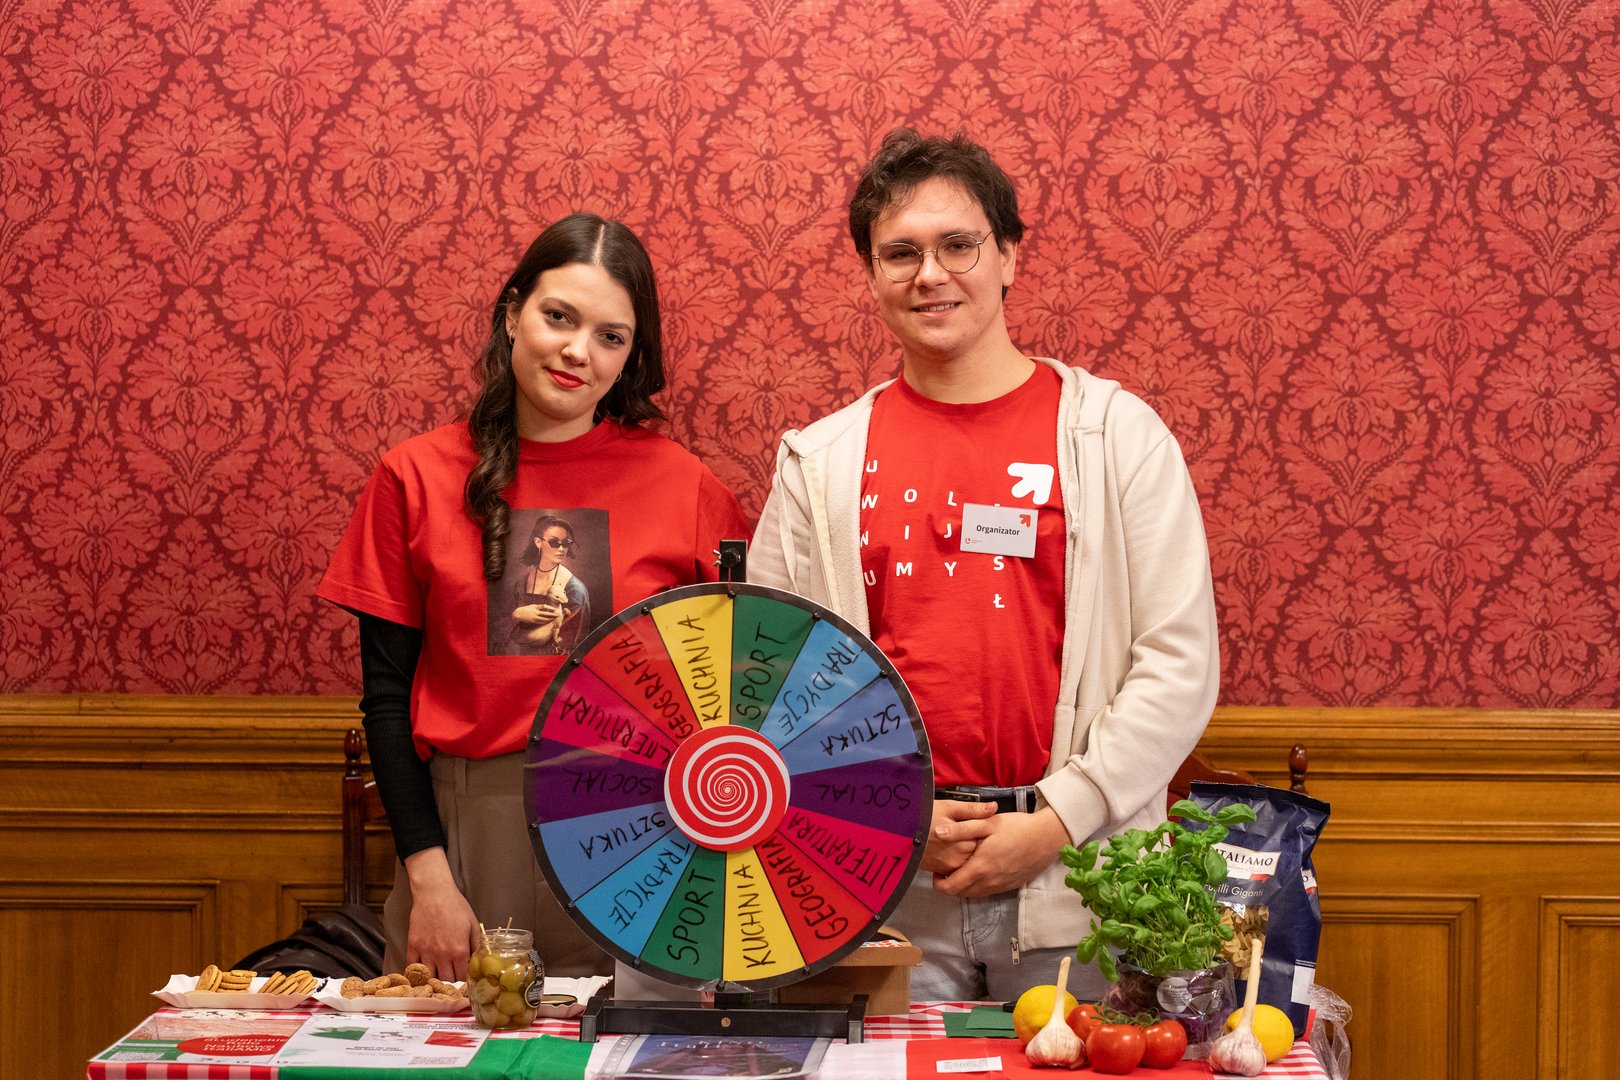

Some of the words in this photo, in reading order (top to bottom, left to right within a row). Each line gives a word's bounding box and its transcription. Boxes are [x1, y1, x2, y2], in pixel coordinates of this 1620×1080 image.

[976, 524, 1020, 537] Organizator
[610, 634, 694, 739] GEOGRAFIA
[677, 614, 723, 722] KUCHNIA
[736, 622, 788, 720] SPORT
[778, 640, 863, 736] TRADYCJE
[560, 692, 671, 765] LITERATURA
[820, 704, 901, 756] SZTUKA
[562, 767, 656, 795] SOCIAL
[812, 783, 911, 811] SOCIAL
[578, 811, 666, 860] SZTUKA
[787, 811, 902, 894] LITERATURA
[608, 839, 692, 934] TRADYCJE
[667, 868, 716, 965] SPORT
[733, 863, 776, 969] KUCHNIA
[762, 835, 849, 940] GEOGRAFIA
[1231, 886, 1264, 899] Giganti
